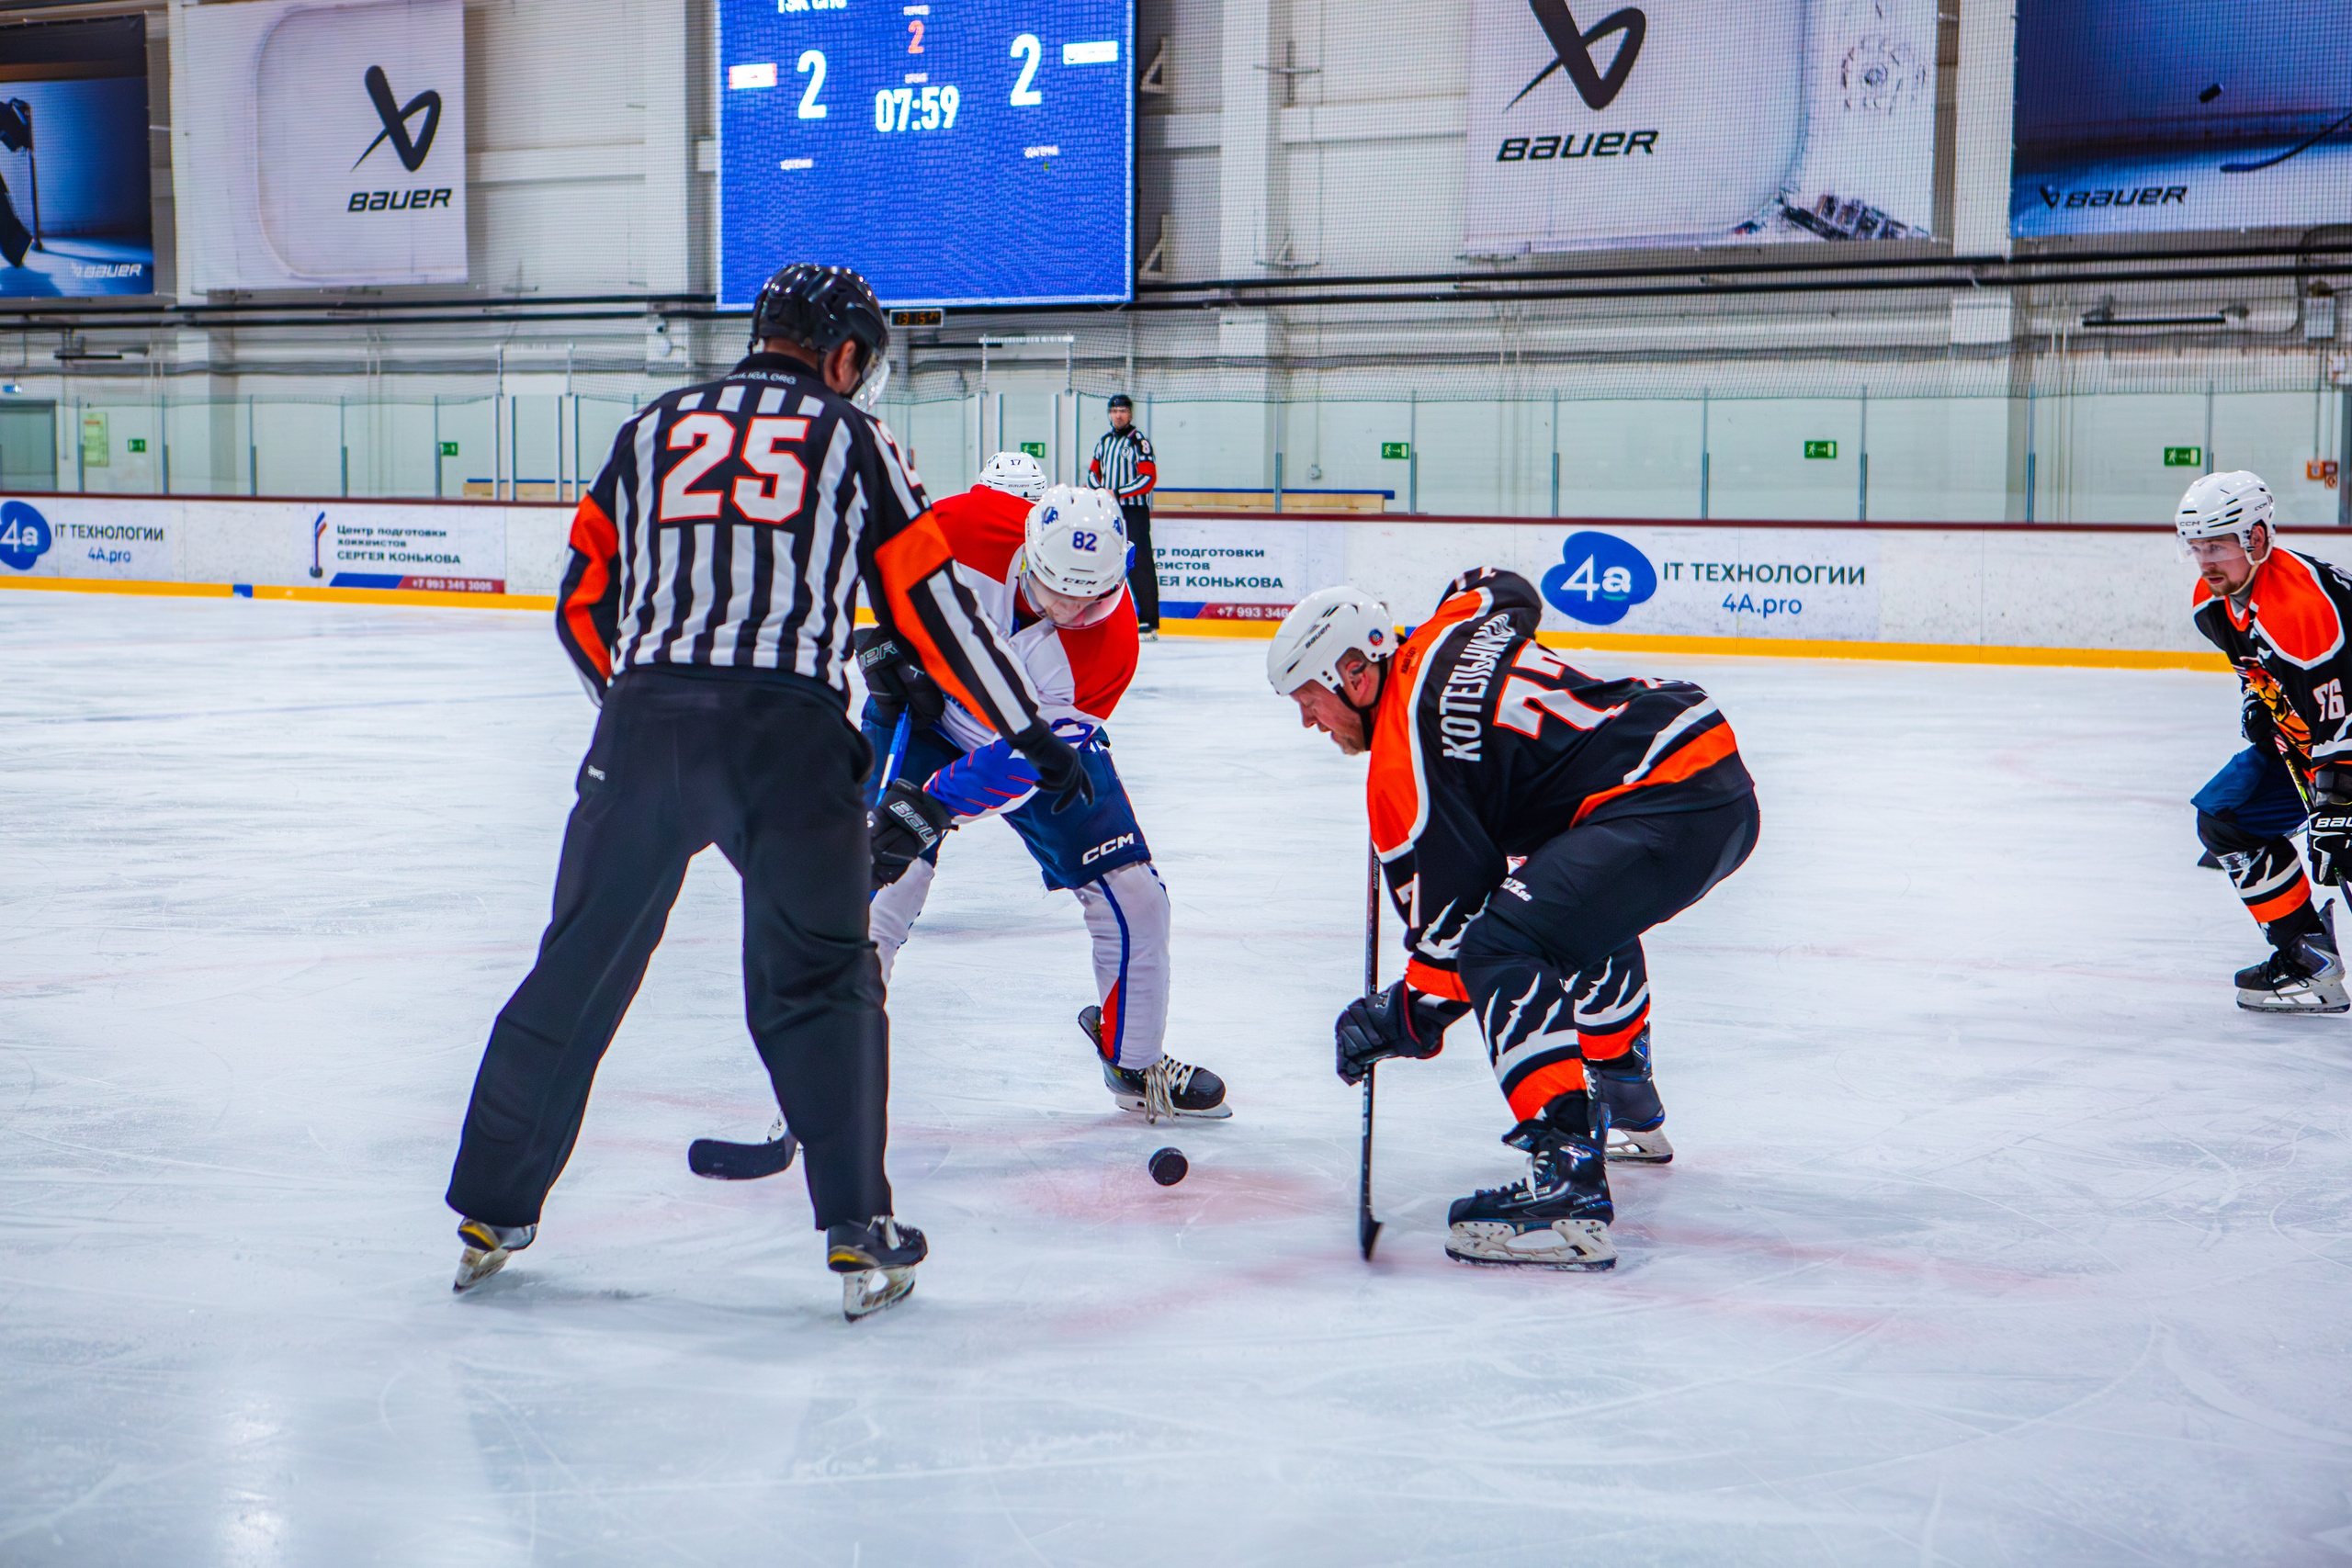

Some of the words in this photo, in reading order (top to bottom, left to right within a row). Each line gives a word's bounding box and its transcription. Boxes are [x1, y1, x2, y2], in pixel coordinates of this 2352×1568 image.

[907, 20, 925, 53] 2
[1010, 33, 1043, 107] 2
[797, 50, 827, 118] 2
[875, 85, 960, 132] 07:59
[1496, 130, 1659, 162] BAUER
[347, 188, 452, 213] BAUER
[2064, 186, 2188, 209] BAUER
[1140, 439, 1152, 455] 8
[658, 411, 811, 525] 25
[54, 524, 67, 538] IT
[71, 524, 164, 541] ТЕХНОЛОГИИ
[336, 525, 374, 537] Центр
[378, 526, 447, 538] подготовки
[1071, 531, 1098, 552] 82
[87, 547, 131, 564] 4A.pro
[336, 550, 385, 561] СЕРГЕЯ
[389, 552, 461, 564] КОНЬКОВА
[1171, 547, 1265, 558] подготовки
[1154, 560, 1211, 570] еистов
[1663, 562, 1684, 581] IT
[1690, 562, 1866, 585] ТЕХНОЛОГИИ
[1062, 577, 1098, 586] CCM
[1185, 575, 1283, 588] КОНЬКОВА
[1560, 553, 1632, 602] 4a
[1216, 606, 1233, 618] +7
[1237, 606, 1261, 619] 993
[1721, 593, 1803, 618] 4A.pro
[1081, 832, 1135, 865] CCM
